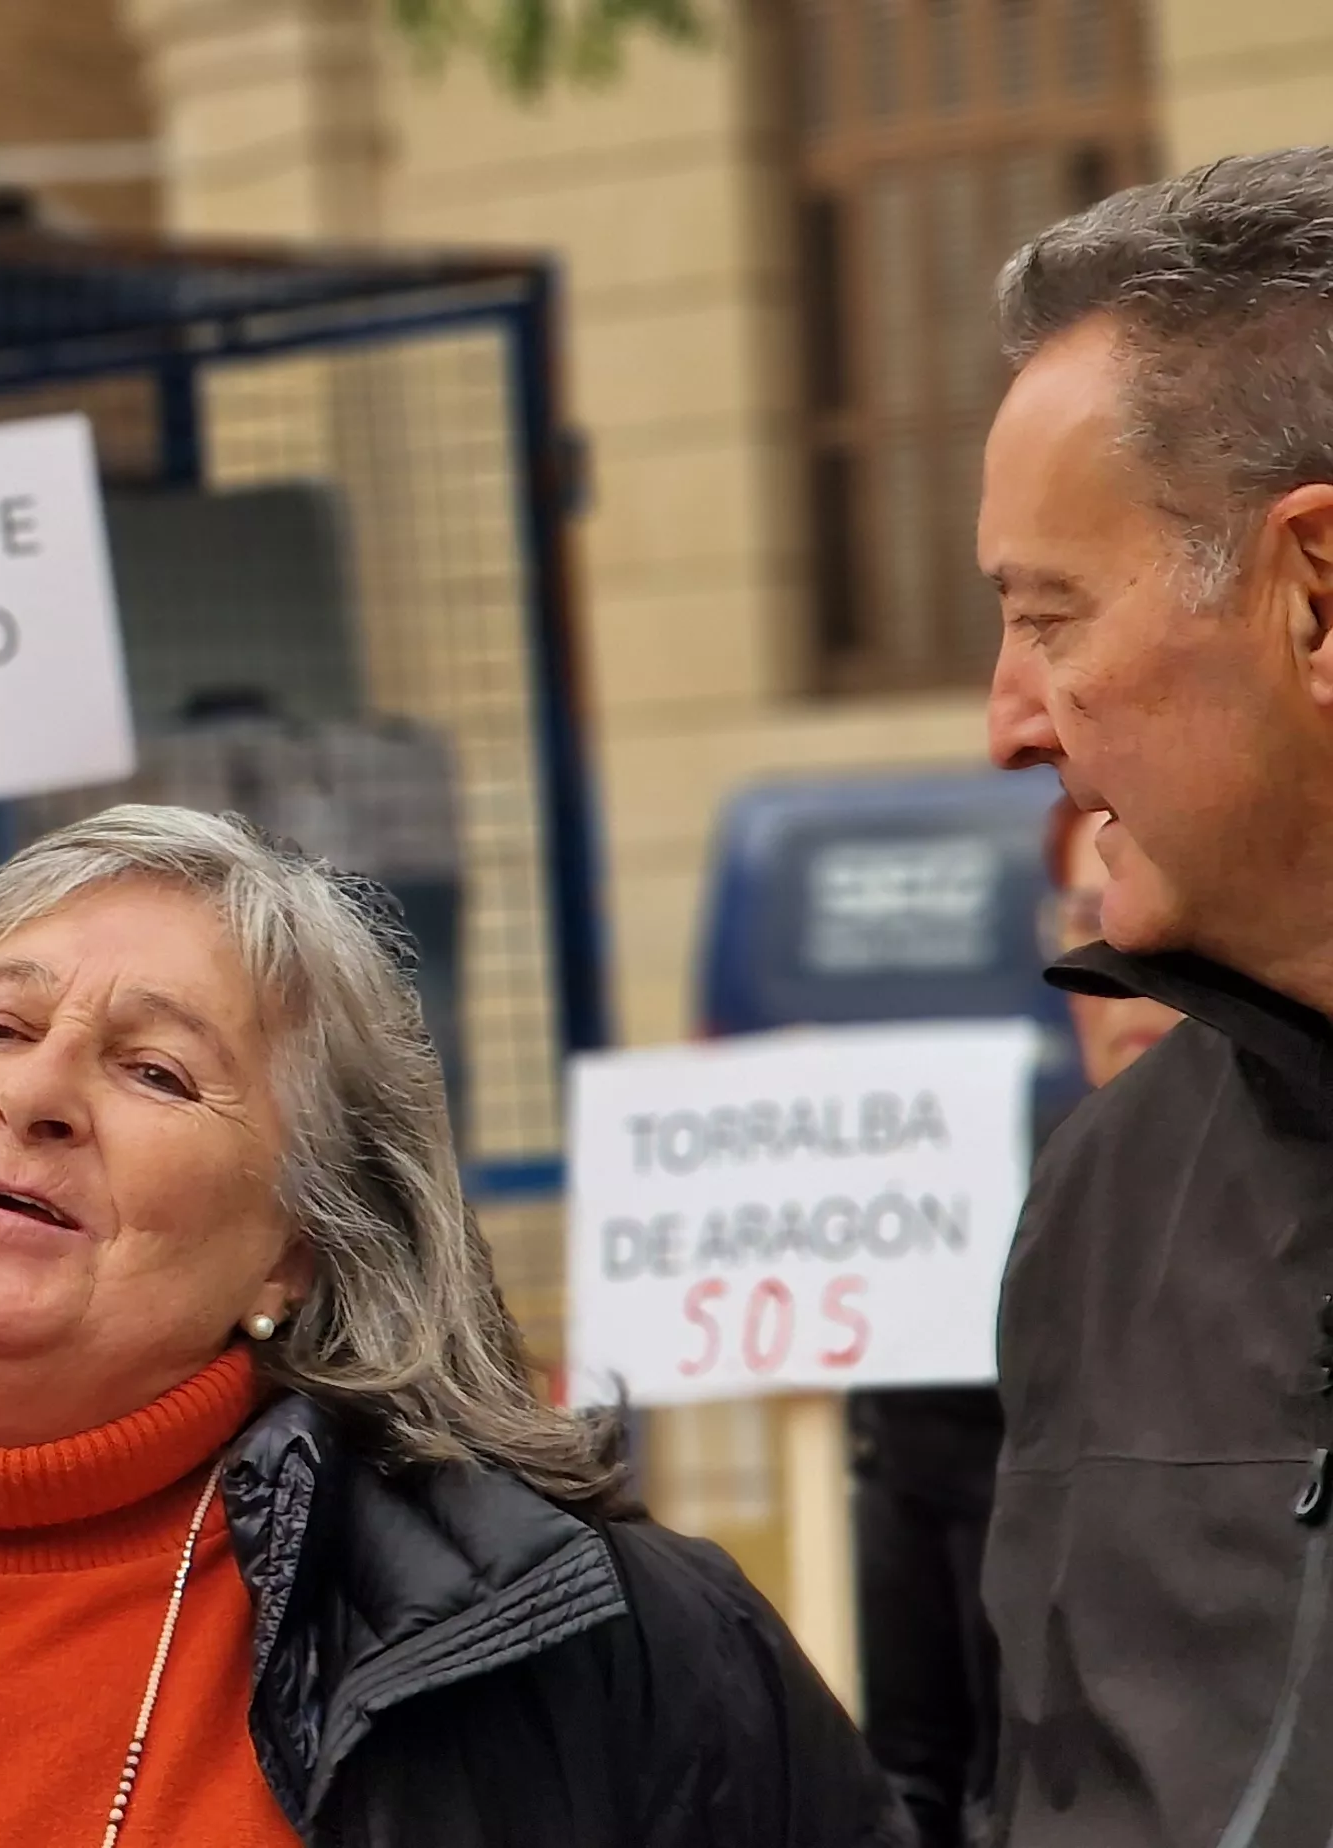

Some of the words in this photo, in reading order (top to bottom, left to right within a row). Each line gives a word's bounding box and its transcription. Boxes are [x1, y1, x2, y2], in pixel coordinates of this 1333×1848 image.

[626, 1089, 951, 1175] TORRALBA
[602, 1211, 684, 1282] DE
[695, 1181, 972, 1268] ARAGÓN
[677, 1274, 871, 1376] SOS
